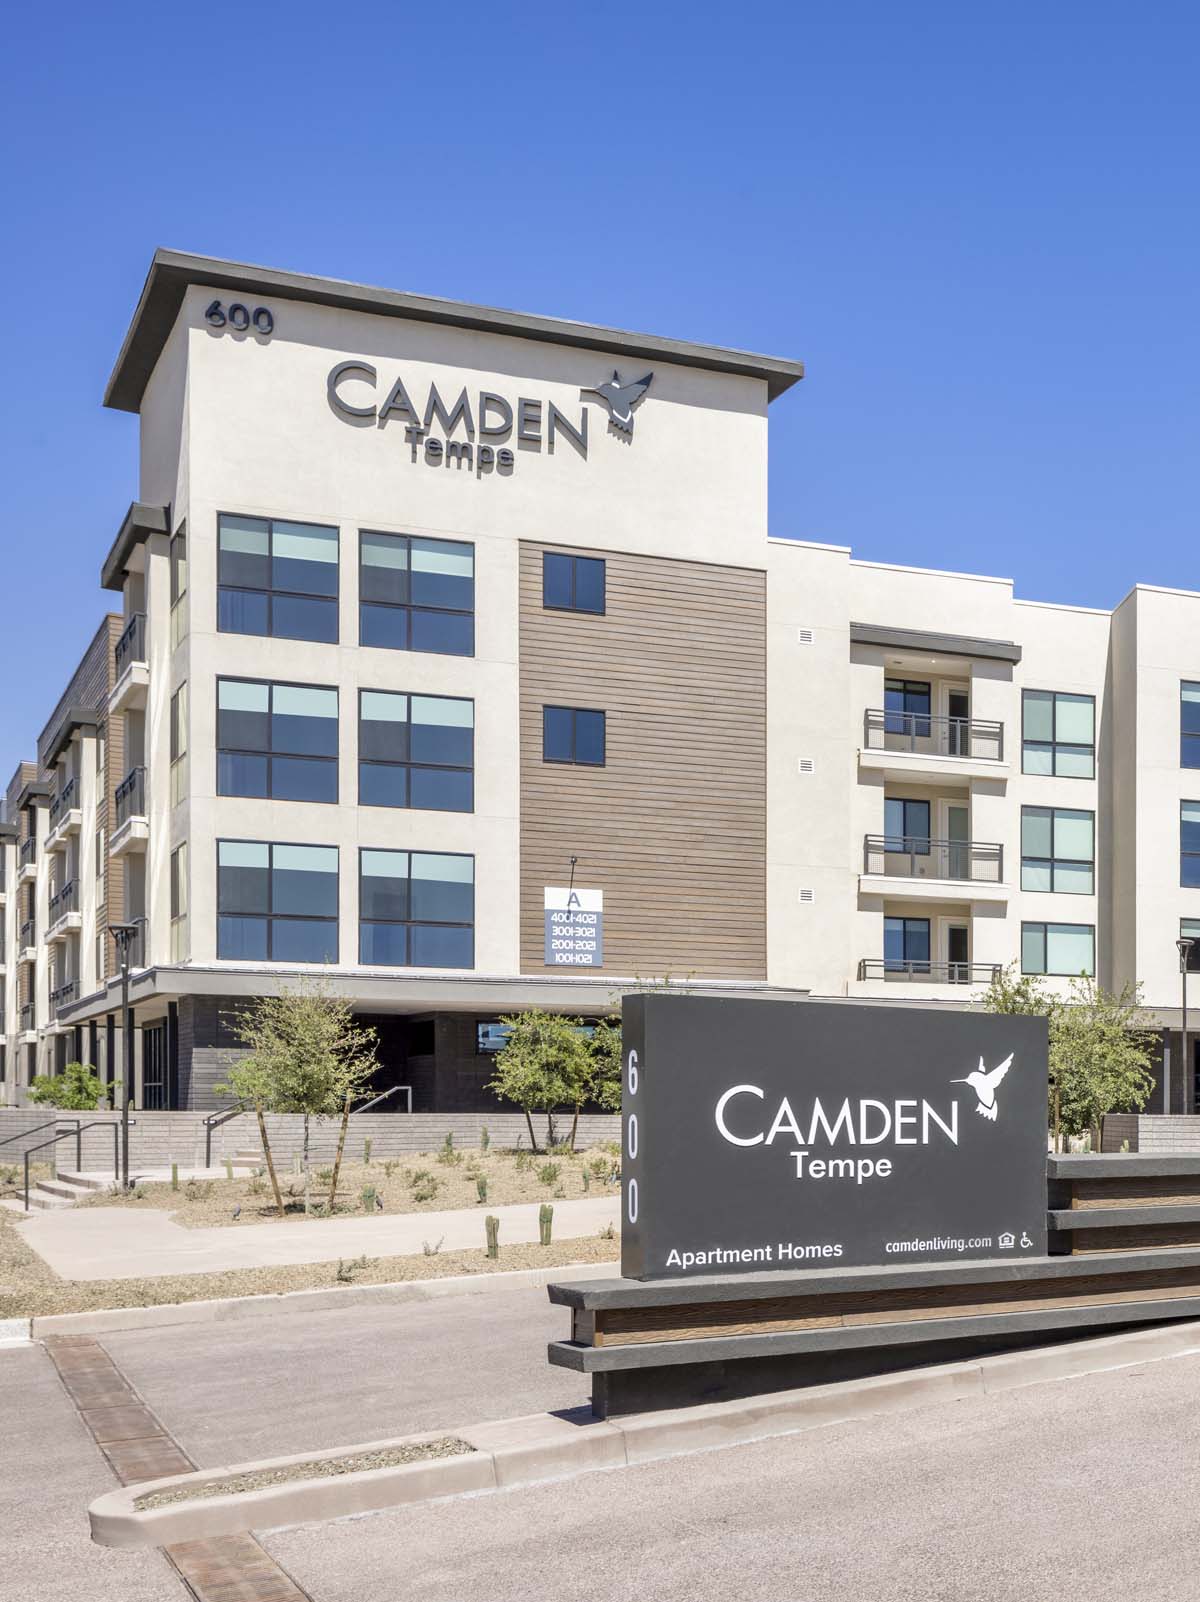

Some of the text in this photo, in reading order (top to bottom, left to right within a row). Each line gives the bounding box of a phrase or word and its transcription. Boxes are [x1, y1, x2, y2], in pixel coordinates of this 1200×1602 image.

[205, 300, 274, 335] 600
[327, 360, 588, 455] CAMDEN
[405, 425, 515, 469] Tempe
[567, 892, 581, 907] A
[551, 912, 597, 924] 4001-4021
[552, 926, 596, 937] 3001-3021
[551, 939, 596, 951] 2001-2021
[555, 952, 592, 964] 1001-1021
[715, 1084, 958, 1147] CAMDEN
[628, 1050, 638, 1224] 600
[790, 1151, 892, 1184] Tempe
[666, 1243, 843, 1269] Apartment Homes
[885, 1236, 992, 1252] camdenliving.com
